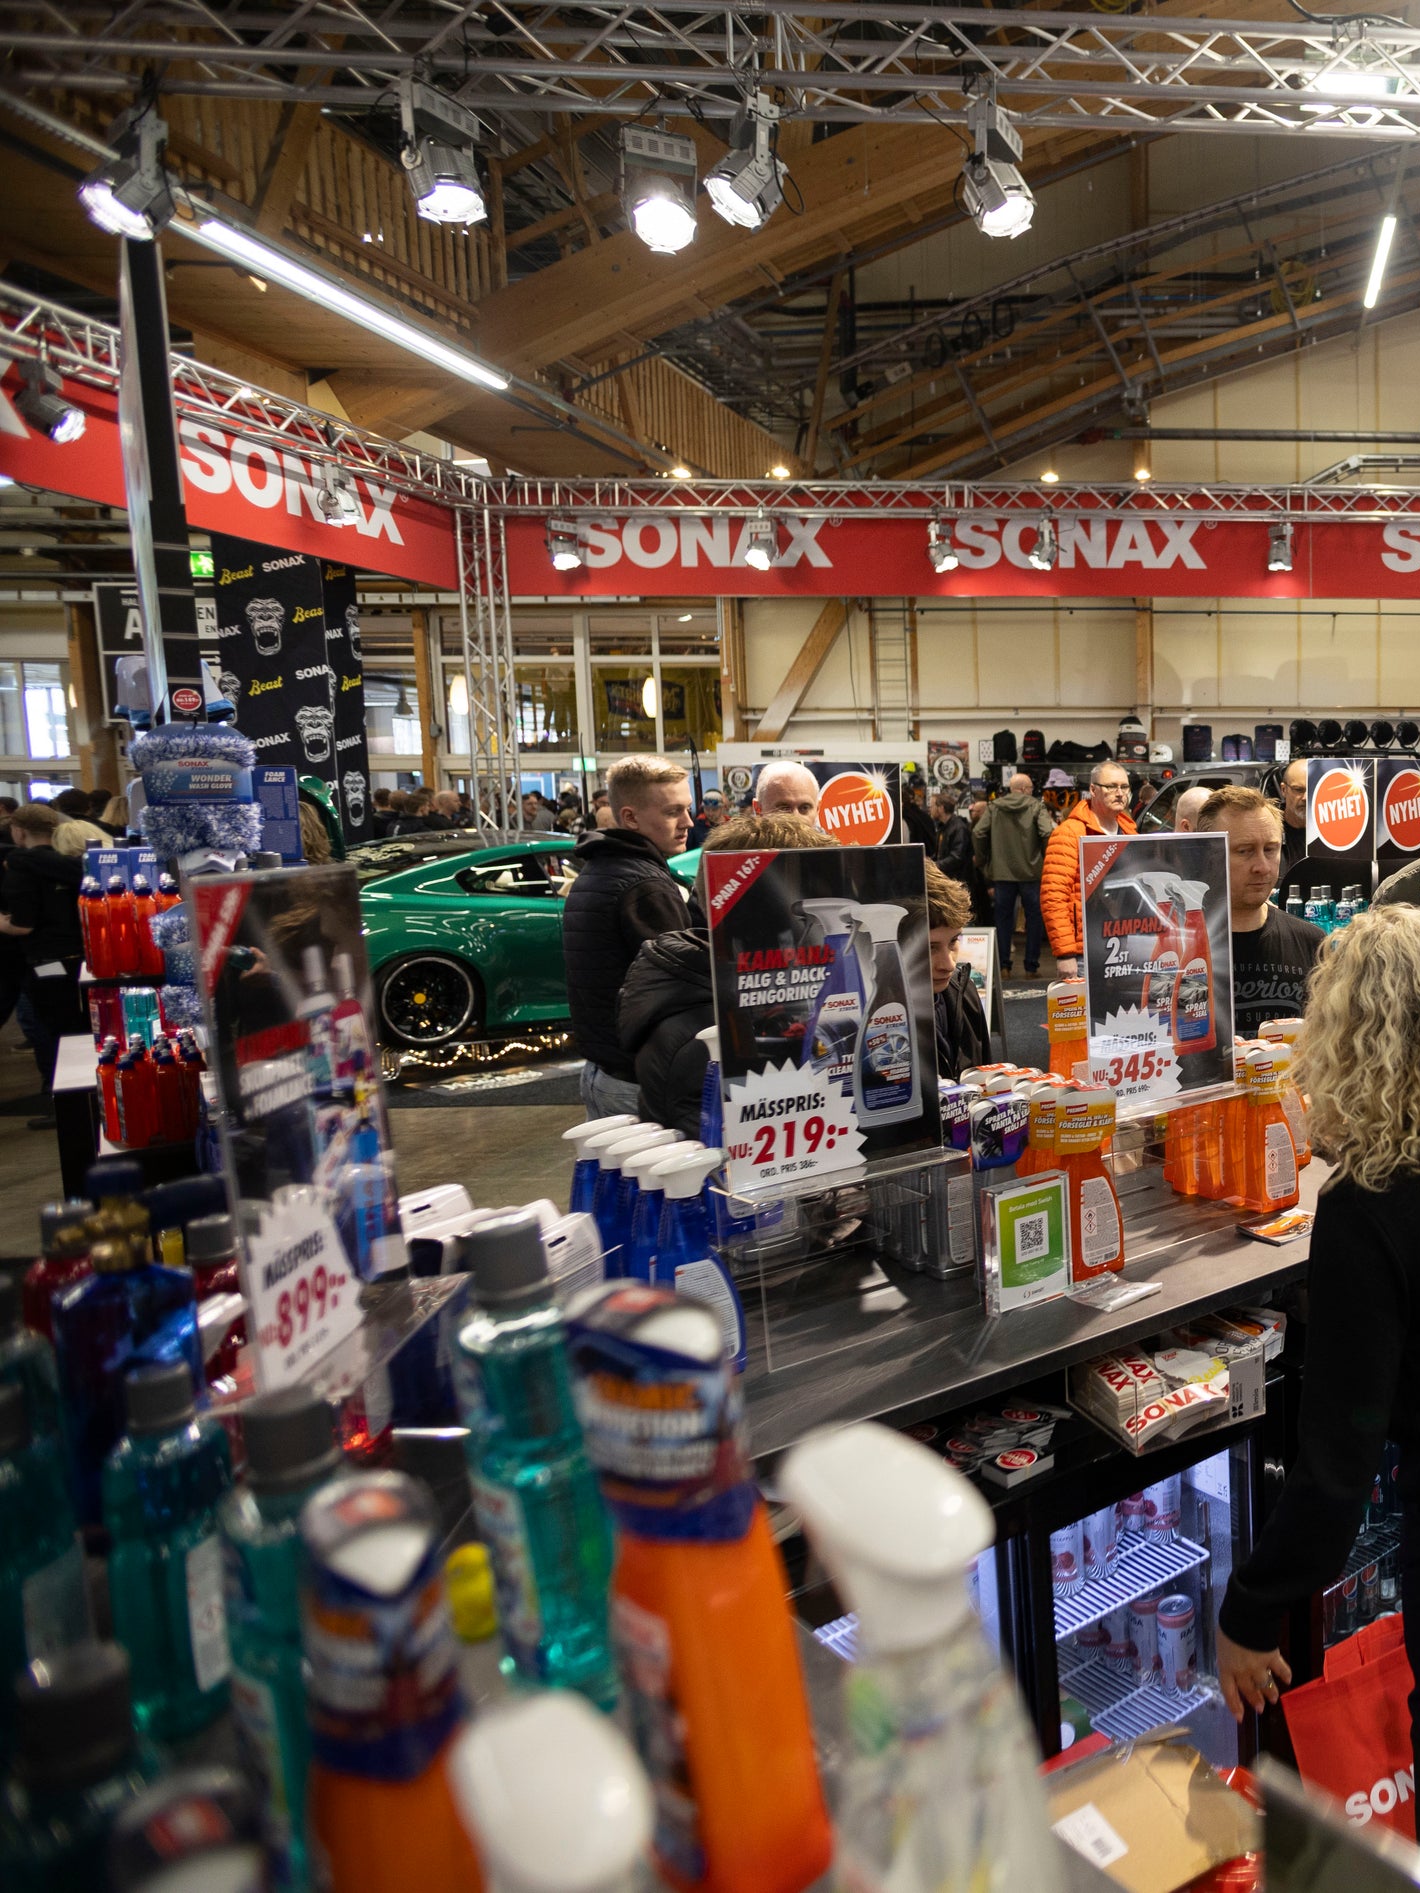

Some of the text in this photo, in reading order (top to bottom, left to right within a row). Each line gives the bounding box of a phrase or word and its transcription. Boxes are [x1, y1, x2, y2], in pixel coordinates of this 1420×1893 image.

[581, 515, 833, 568] SONAX
[955, 515, 1207, 569] SONAX
[219, 555, 306, 586] Beast SONAX
[292, 606, 323, 624] Beas
[217, 624, 242, 639] NAX
[325, 627, 344, 641] NAX
[295, 663, 331, 681] SONA
[248, 676, 283, 696] Beast
[336, 734, 362, 751] SONAX
[178, 760, 209, 768] SONAX
[189, 781, 233, 790] WASH GLOVE
[191, 774, 232, 783] WONDER
[824, 798, 883, 830] NYHET
[1318, 795, 1362, 824] NYHET
[1086, 860, 1106, 886] SPARA
[711, 878, 741, 909] SPARA
[736, 944, 836, 973] KAMPANJ:
[775, 971, 787, 985] &
[1104, 964, 1133, 979] SPRAY
[1143, 961, 1162, 973] SEAL
[1186, 967, 1205, 976] SONAX
[1233, 975, 1303, 1000] perior
[828, 999, 856, 1008] SONAX
[1185, 1001, 1207, 1013] SPRAY
[874, 1014, 903, 1025] SONAX
[1108, 1051, 1171, 1086] 345:-
[739, 1091, 825, 1124] MÄSSPRIS:
[752, 1116, 849, 1166] 219:-
[760, 1166, 778, 1179] ORD.
[780, 1161, 798, 1175] PRIS
[1098, 1362, 1134, 1392] NAX
[1121, 1356, 1160, 1384] NAX
[1345, 1763, 1415, 1828] SON
